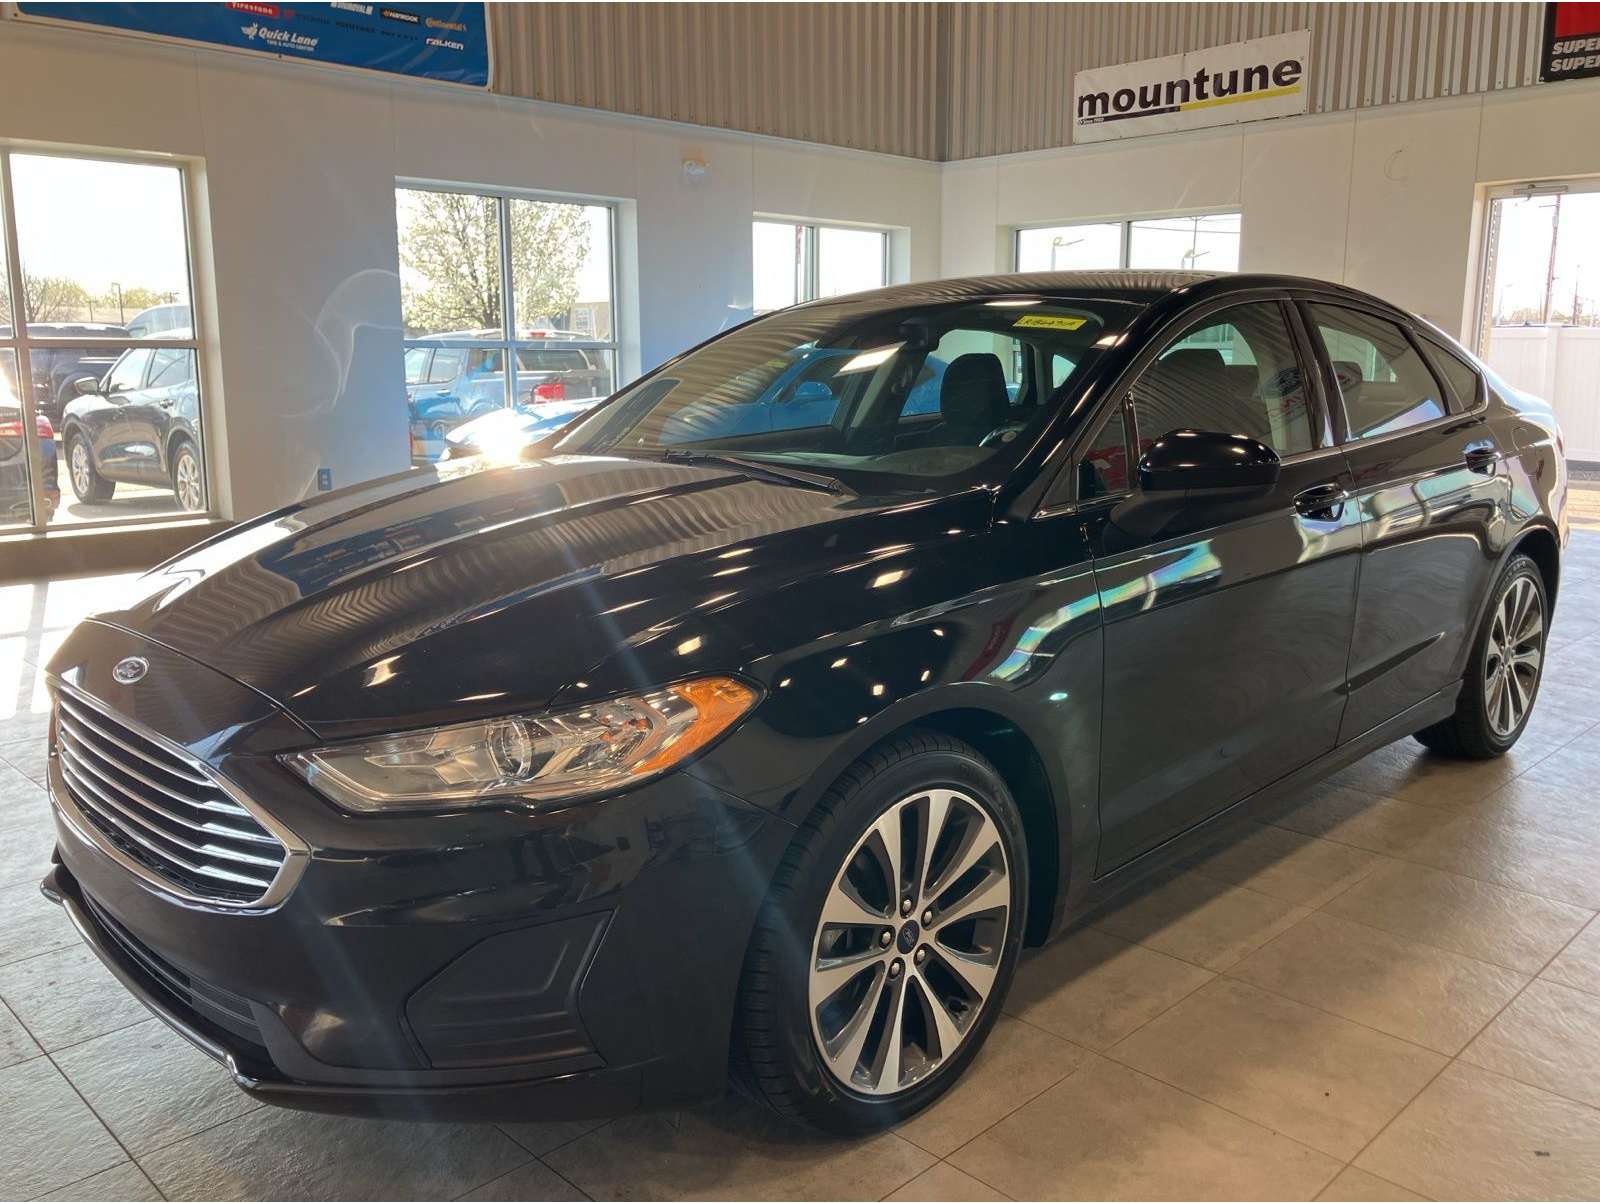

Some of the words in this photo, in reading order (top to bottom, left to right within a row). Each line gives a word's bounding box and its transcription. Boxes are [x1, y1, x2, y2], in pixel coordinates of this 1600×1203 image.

[259, 27, 290, 41] Quick
[291, 33, 319, 46] Lane
[1077, 59, 1302, 117] mountune
